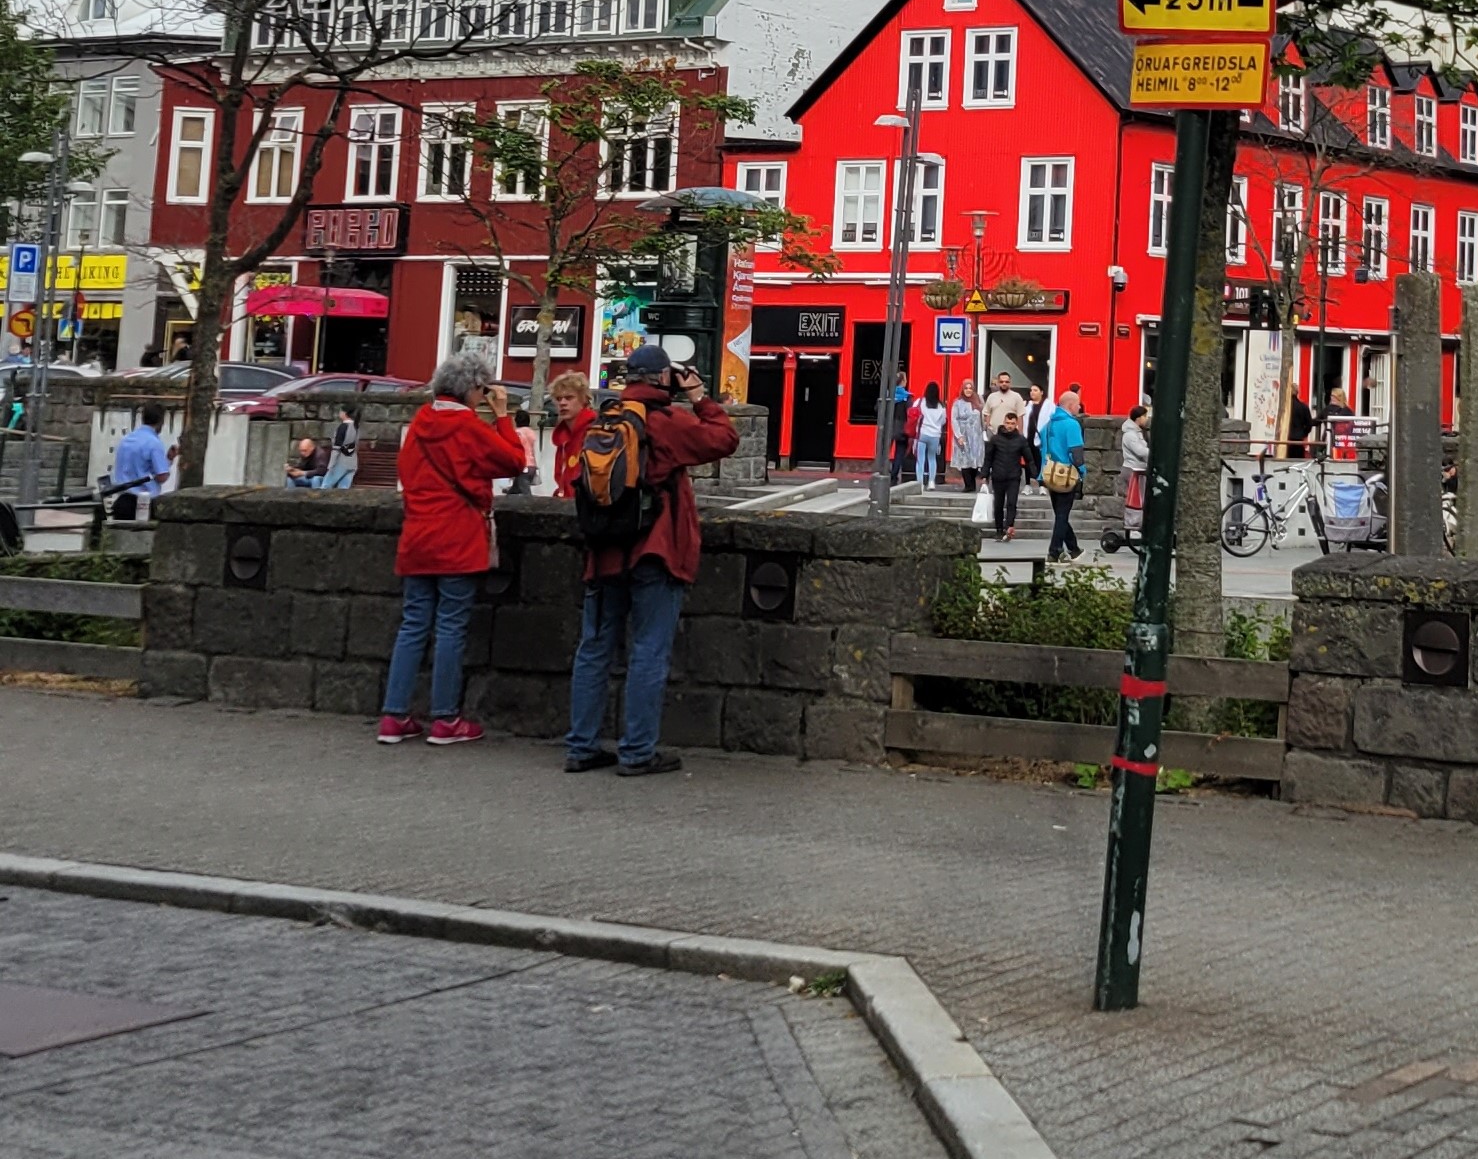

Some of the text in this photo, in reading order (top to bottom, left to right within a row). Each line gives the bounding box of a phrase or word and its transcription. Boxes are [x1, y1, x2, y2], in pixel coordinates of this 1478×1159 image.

[1136, 76, 1180, 92] HEIMIL
[77, 265, 120, 280] IKING
[647, 312, 660, 321] WC
[798, 312, 840, 333] EXIT
[942, 330, 961, 341] WC
